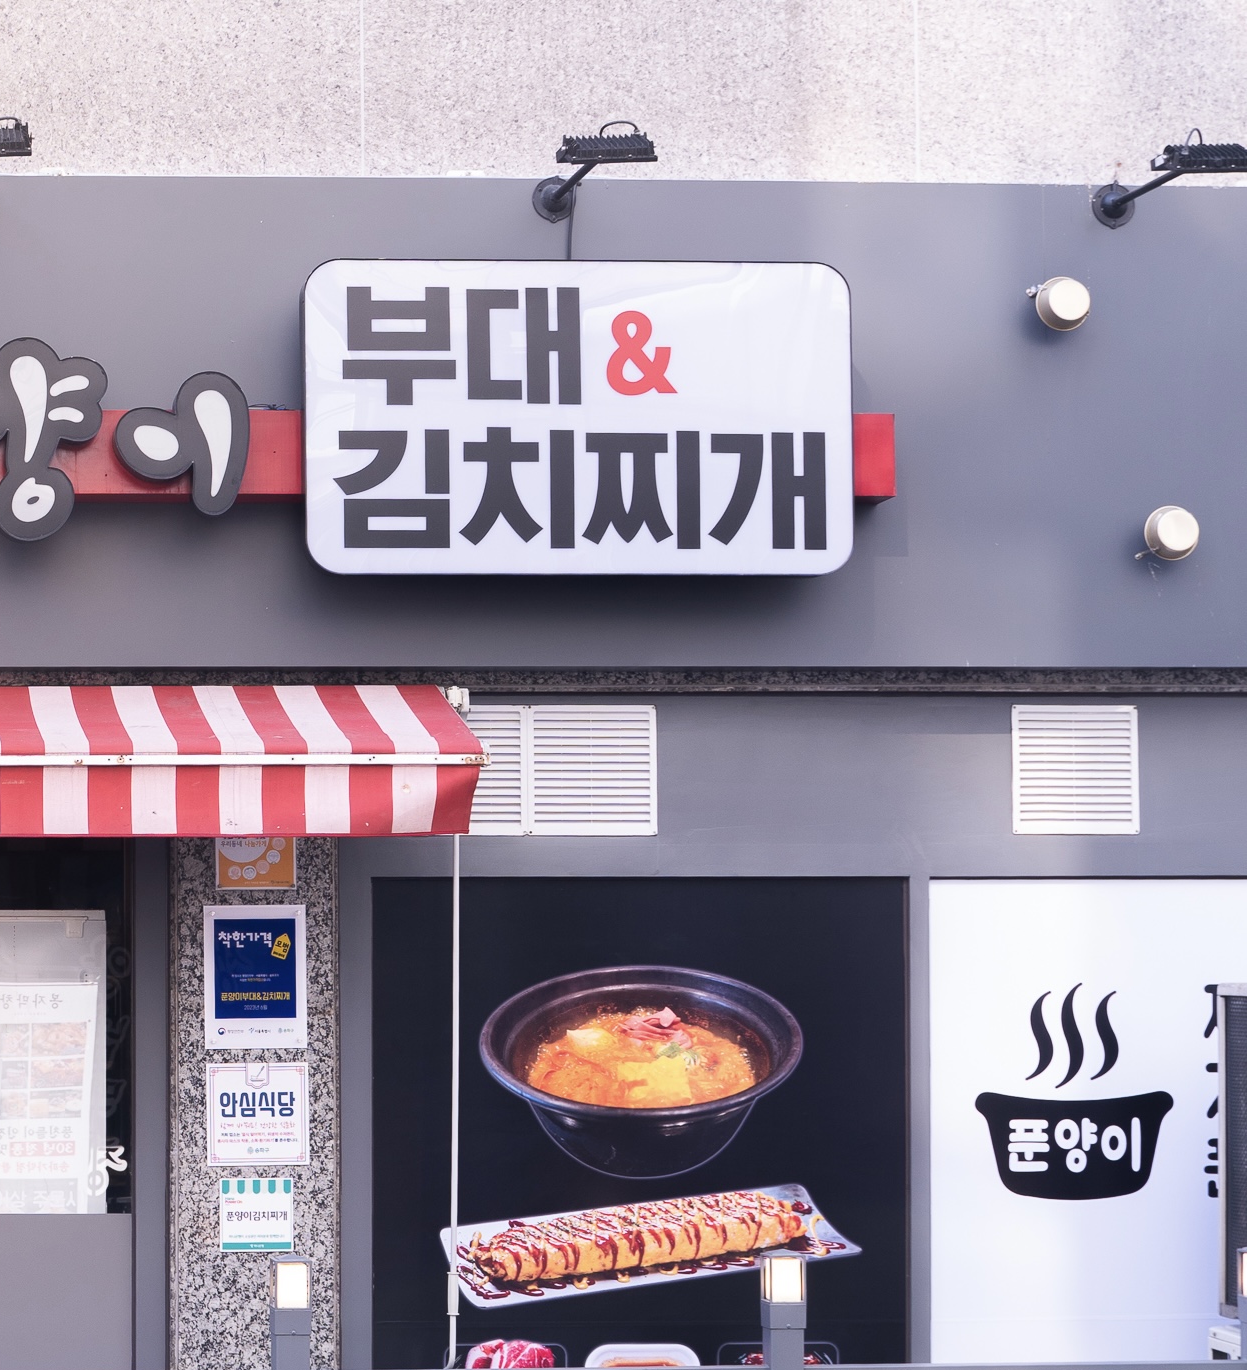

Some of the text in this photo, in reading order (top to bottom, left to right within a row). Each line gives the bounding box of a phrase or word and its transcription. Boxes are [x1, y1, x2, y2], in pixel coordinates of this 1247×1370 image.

[342, 286, 678, 406] 부대 &
[331, 426, 828, 551] 김치찌개
[218, 931, 272, 948] 착한가격
[219, 1091, 295, 1118] 안심식당
[1007, 1116, 1142, 1174] 푼양이
[226, 1211, 288, 1222] 푼양이김치찌개
